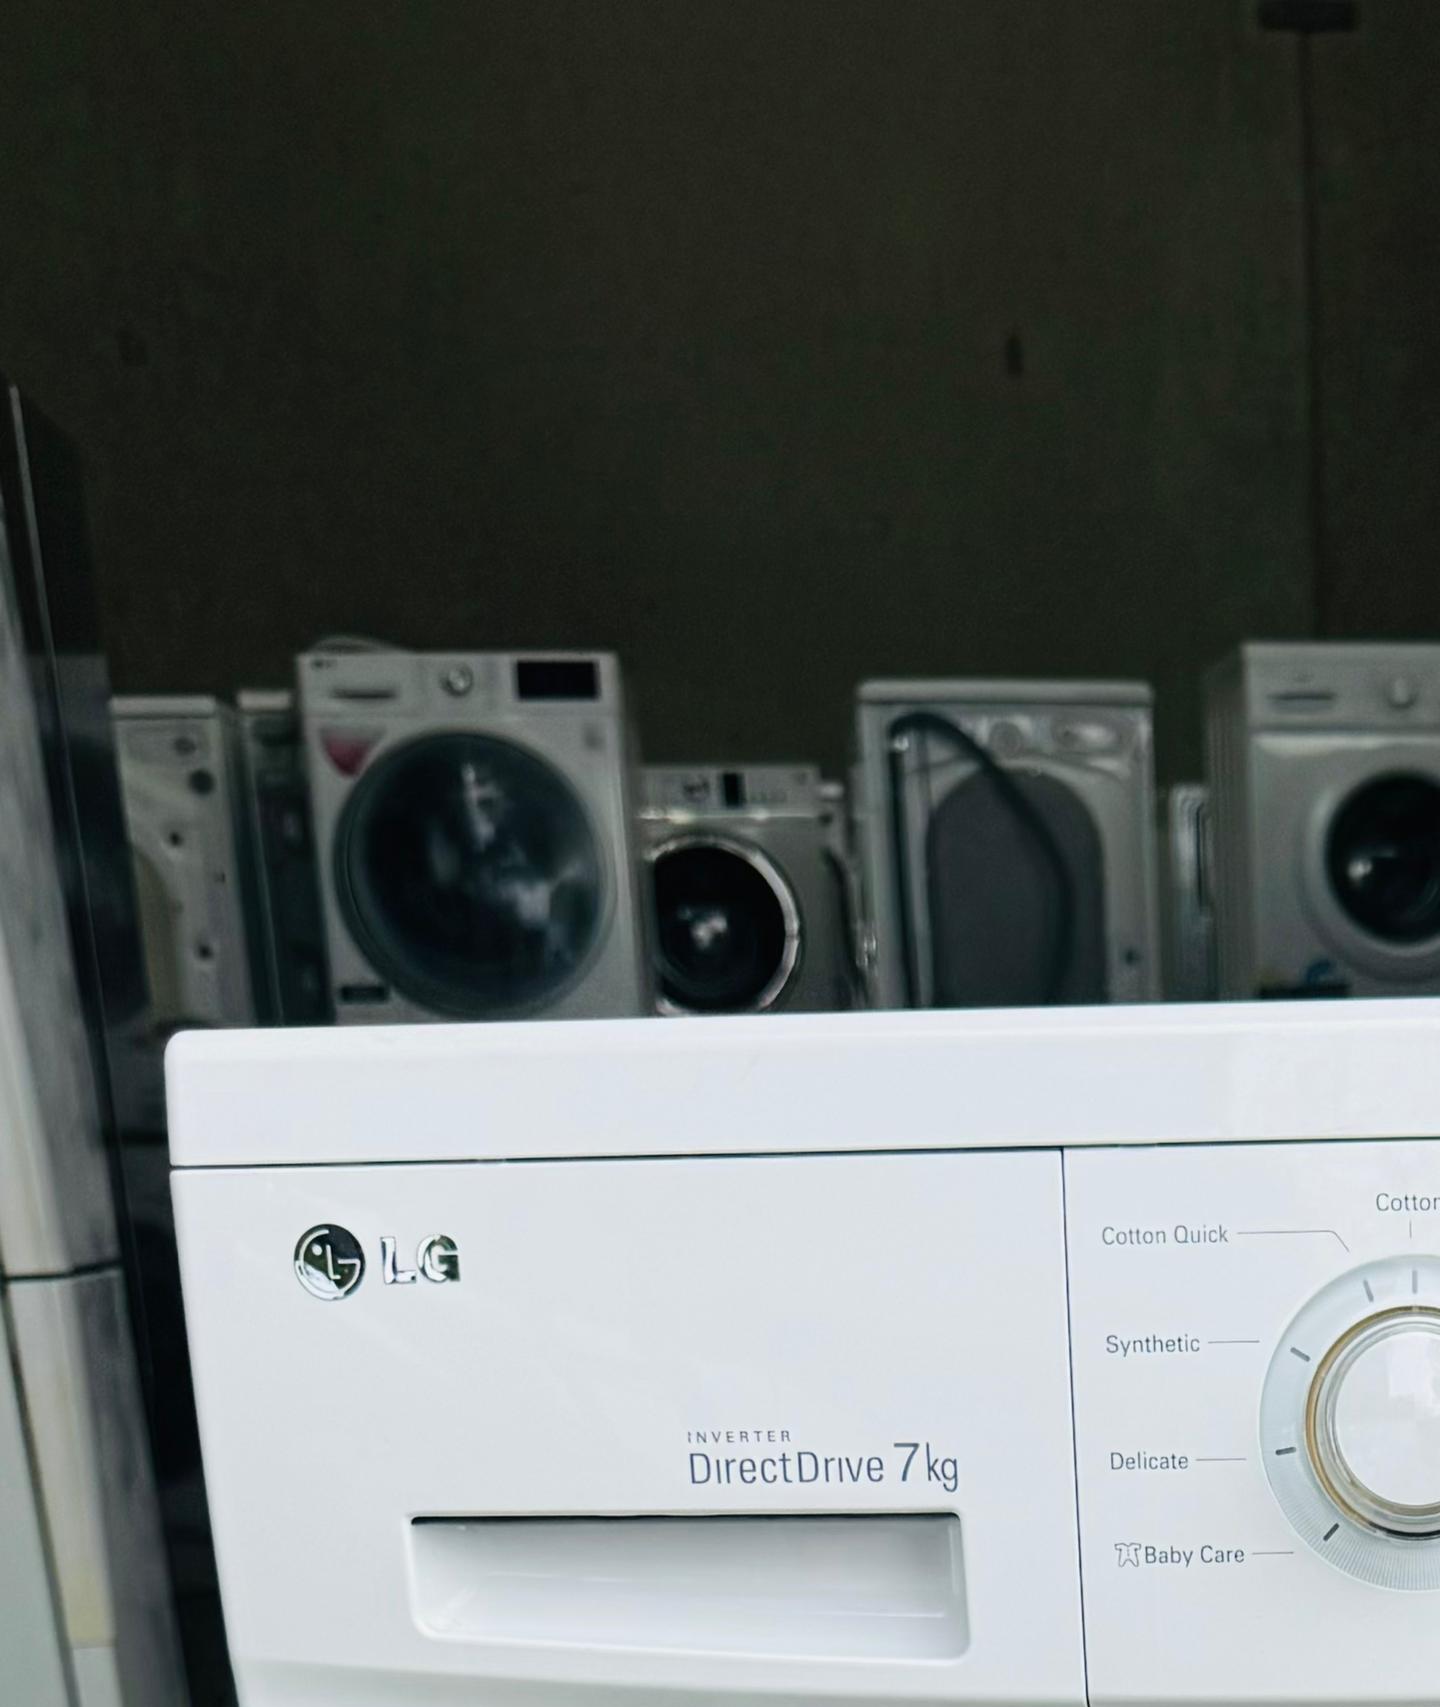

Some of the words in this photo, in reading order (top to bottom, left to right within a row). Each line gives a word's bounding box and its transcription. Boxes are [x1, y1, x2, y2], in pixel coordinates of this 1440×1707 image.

[1102, 1227, 1166, 1245] Cotton
[1174, 1225, 1228, 1243] Quick
[380, 1234, 460, 1284] LG
[1107, 1334, 1199, 1357] Synthetic
[688, 1431, 790, 1443] INVERTER
[1111, 1452, 1188, 1470] Delicate
[1145, 1546, 1193, 1567] Baby
[1201, 1545, 1244, 1563] Care
